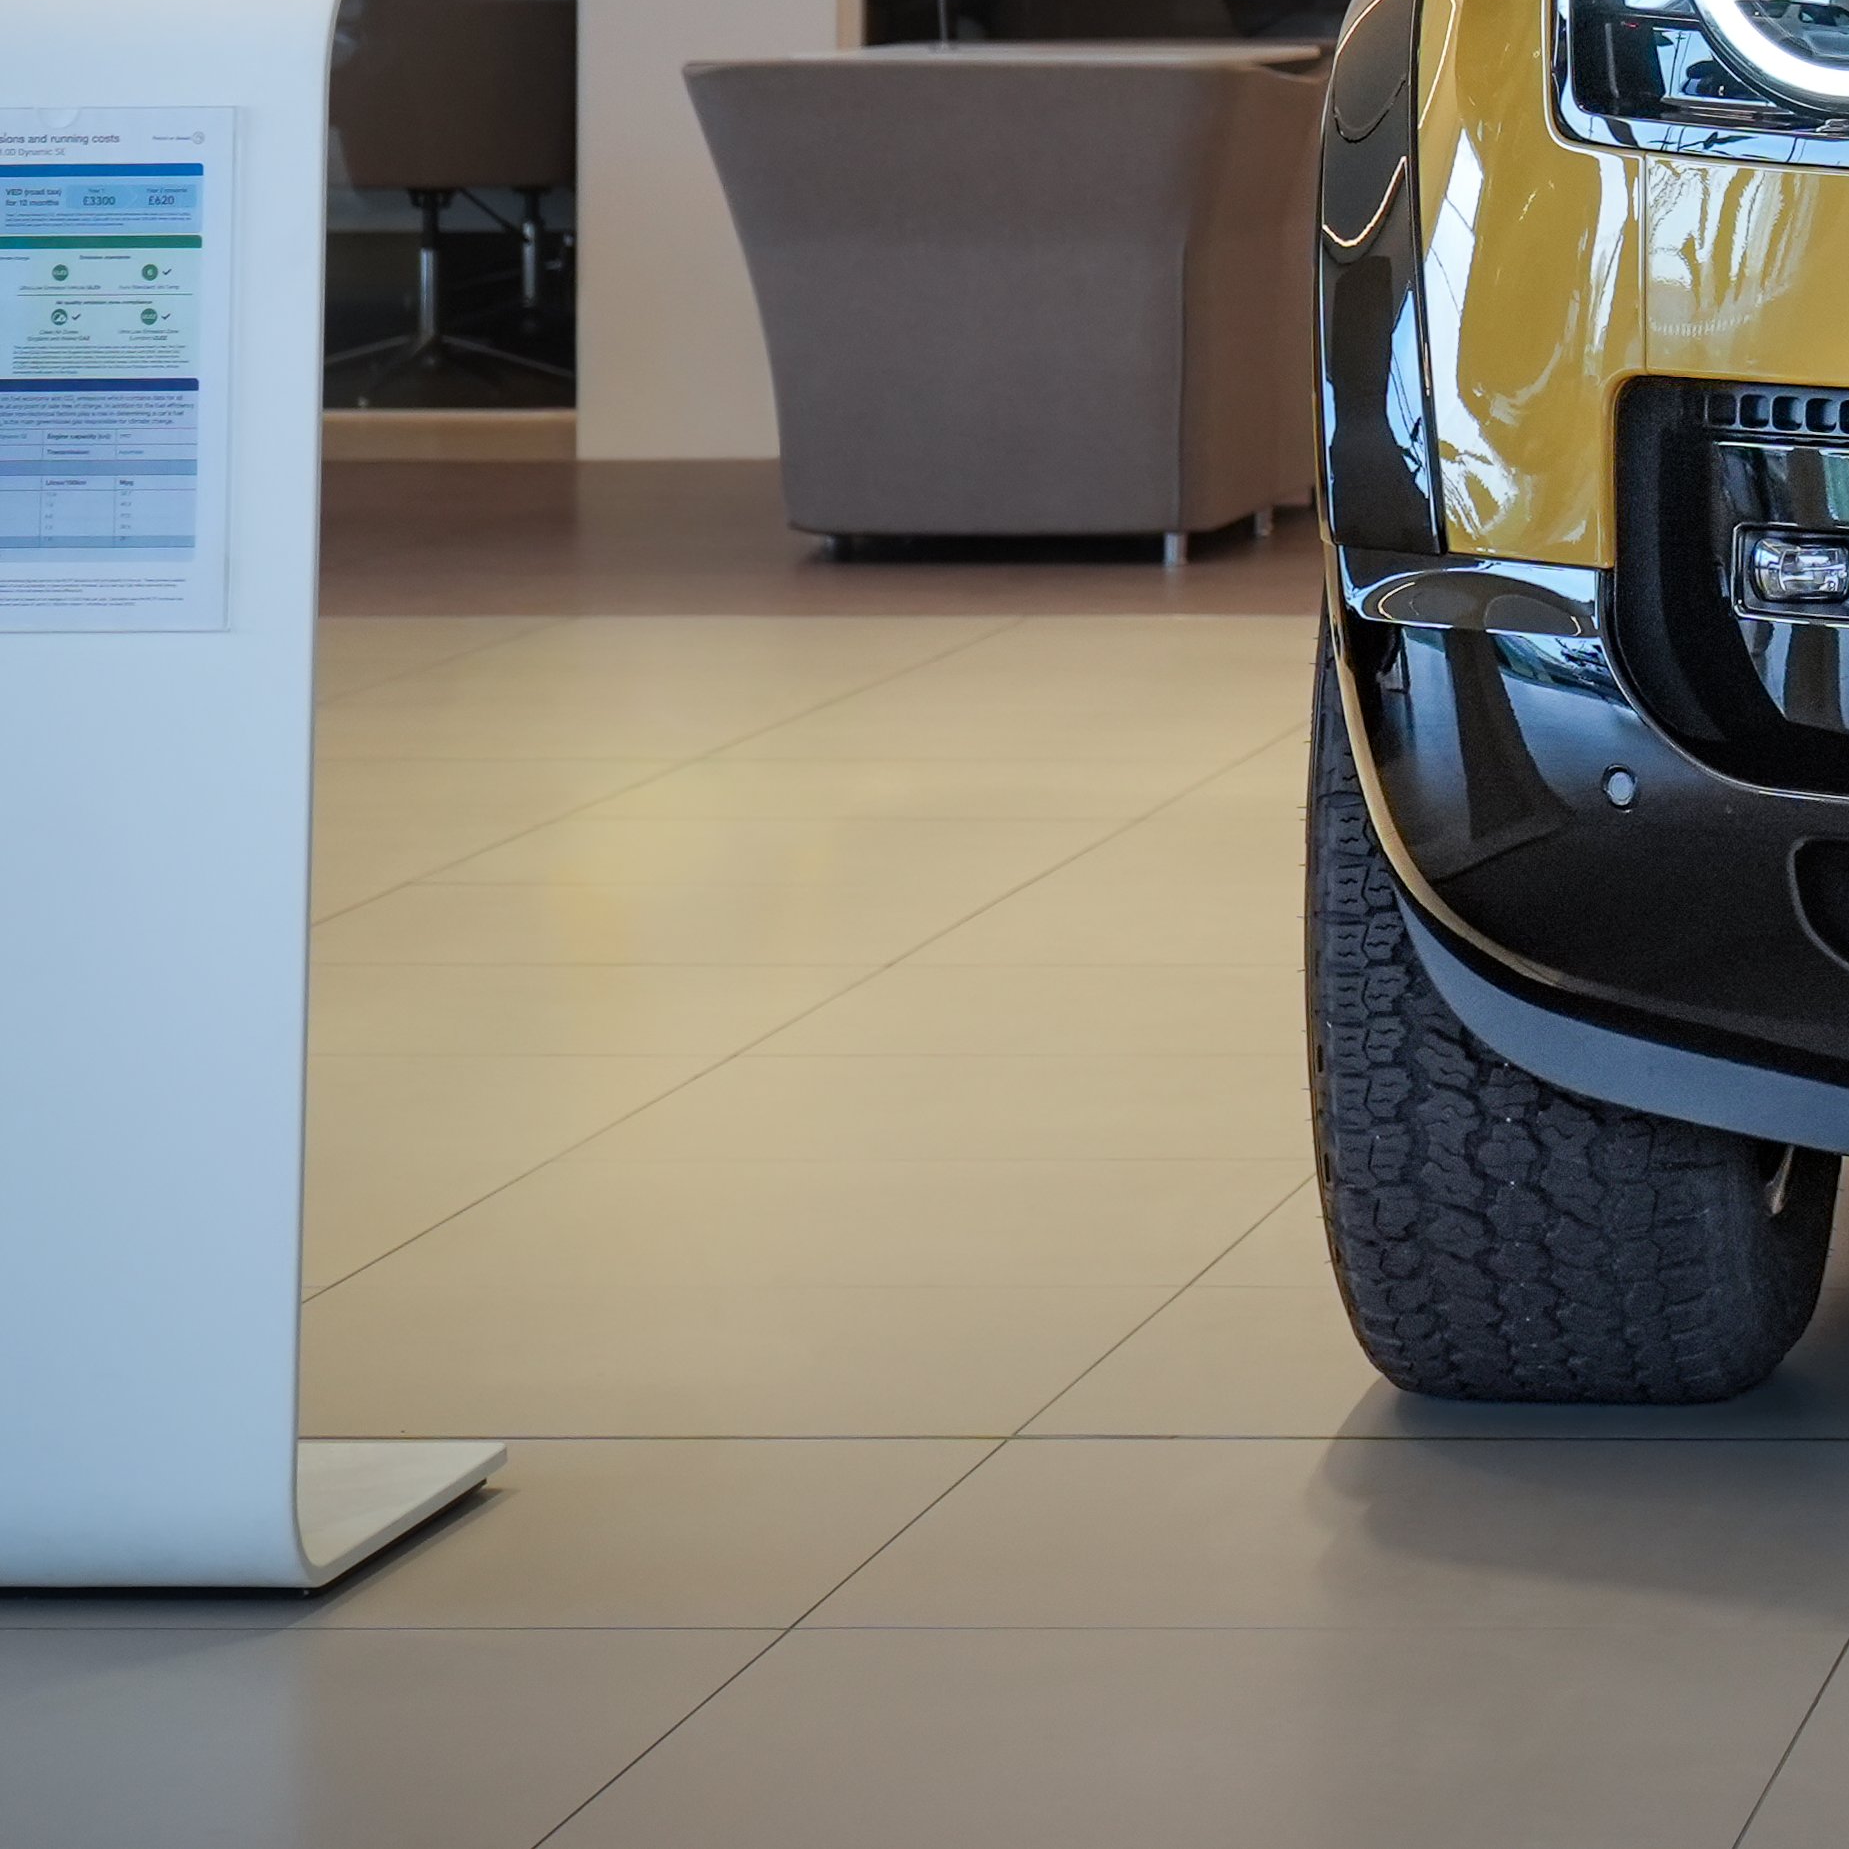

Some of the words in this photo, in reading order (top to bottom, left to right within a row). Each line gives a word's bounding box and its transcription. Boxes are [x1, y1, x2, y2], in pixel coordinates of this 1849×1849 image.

[28, 134, 48, 144] and
[51, 134, 89, 146] running
[92, 134, 121, 144] costs
[83, 196, 116, 206] £3300
[148, 195, 175, 206] £620
